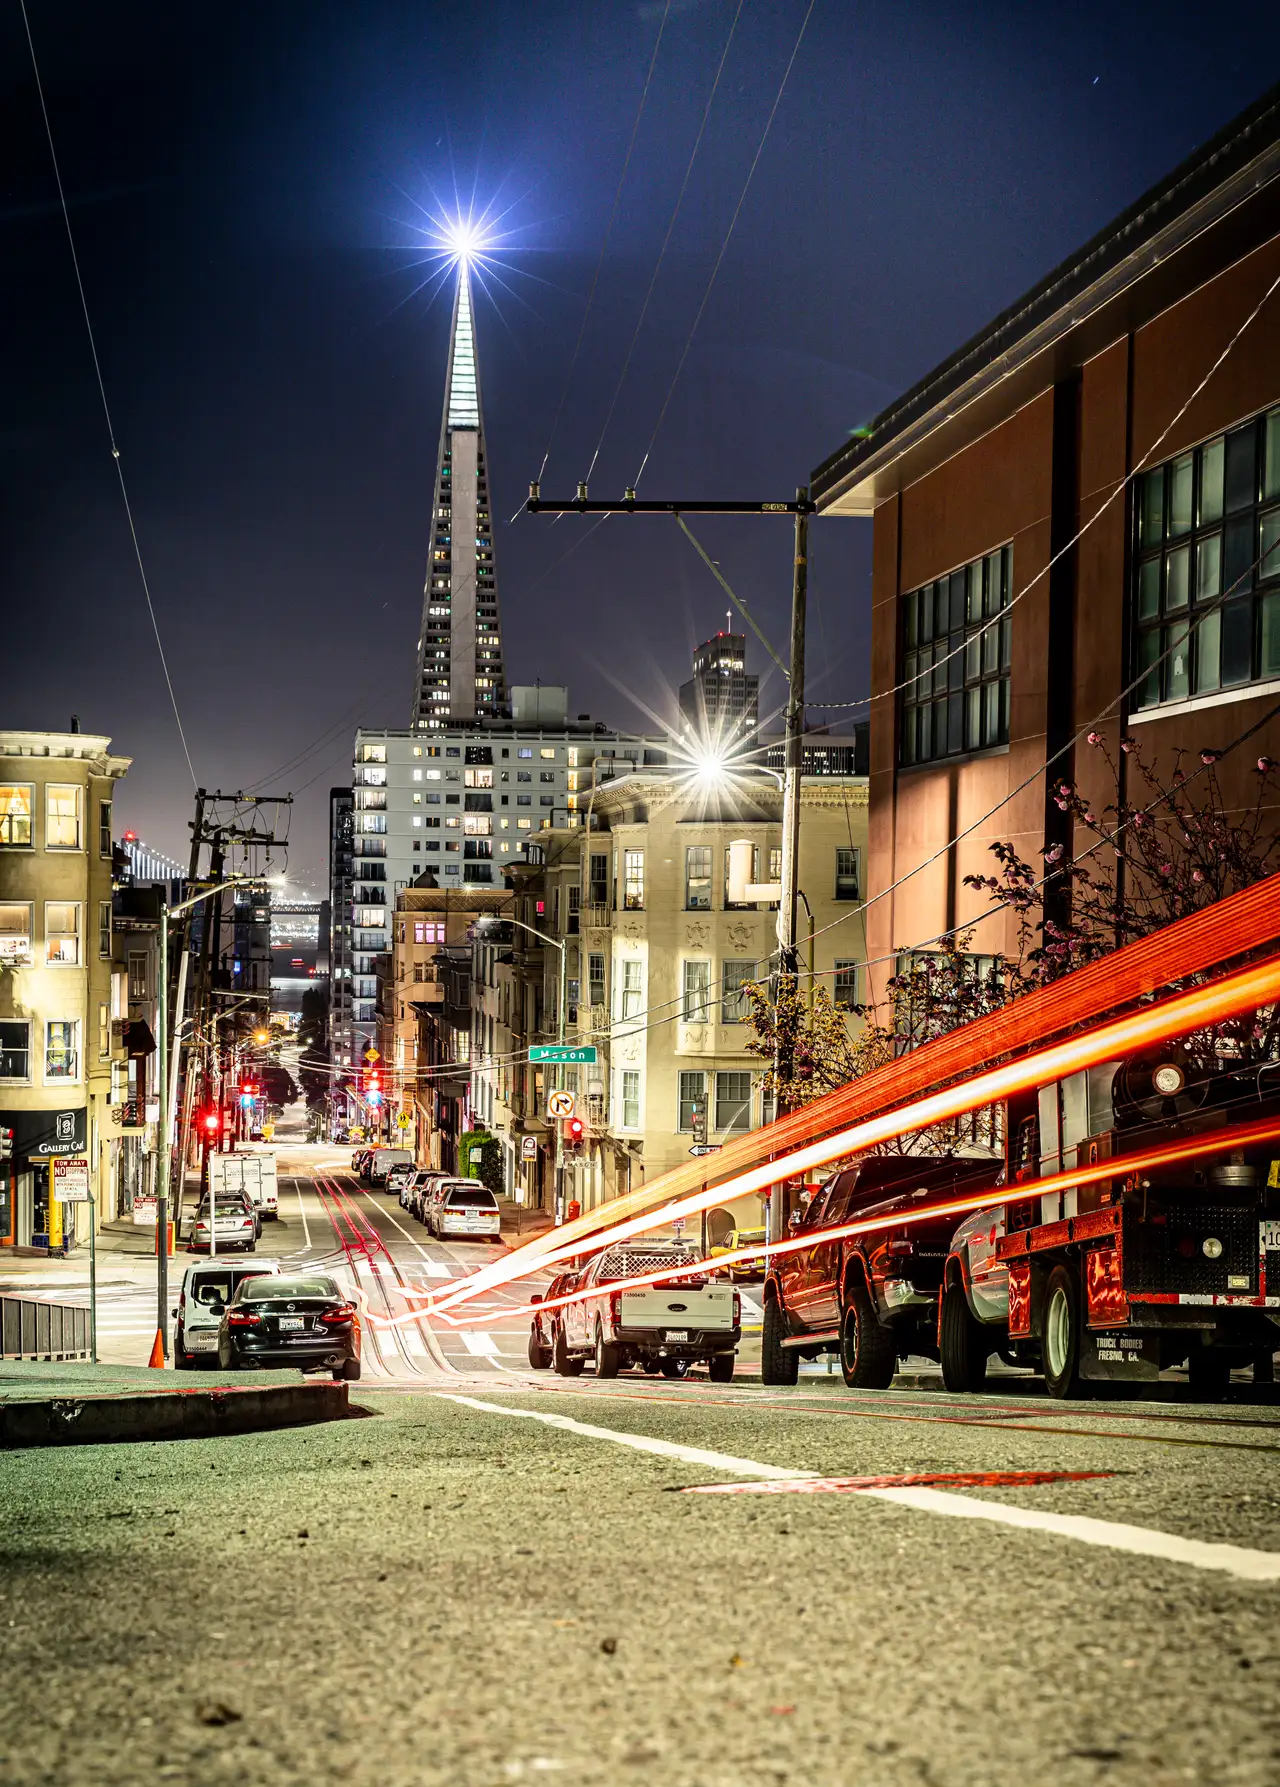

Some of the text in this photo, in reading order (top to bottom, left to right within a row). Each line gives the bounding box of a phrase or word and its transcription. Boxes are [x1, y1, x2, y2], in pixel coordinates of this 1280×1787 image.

[540, 1050, 585, 1060] Mason
[55, 1166, 66, 1176] NO
[1096, 1337, 1143, 1349] TRUCK BODIES
[1098, 1350, 1140, 1363] FRESNO, CA.
